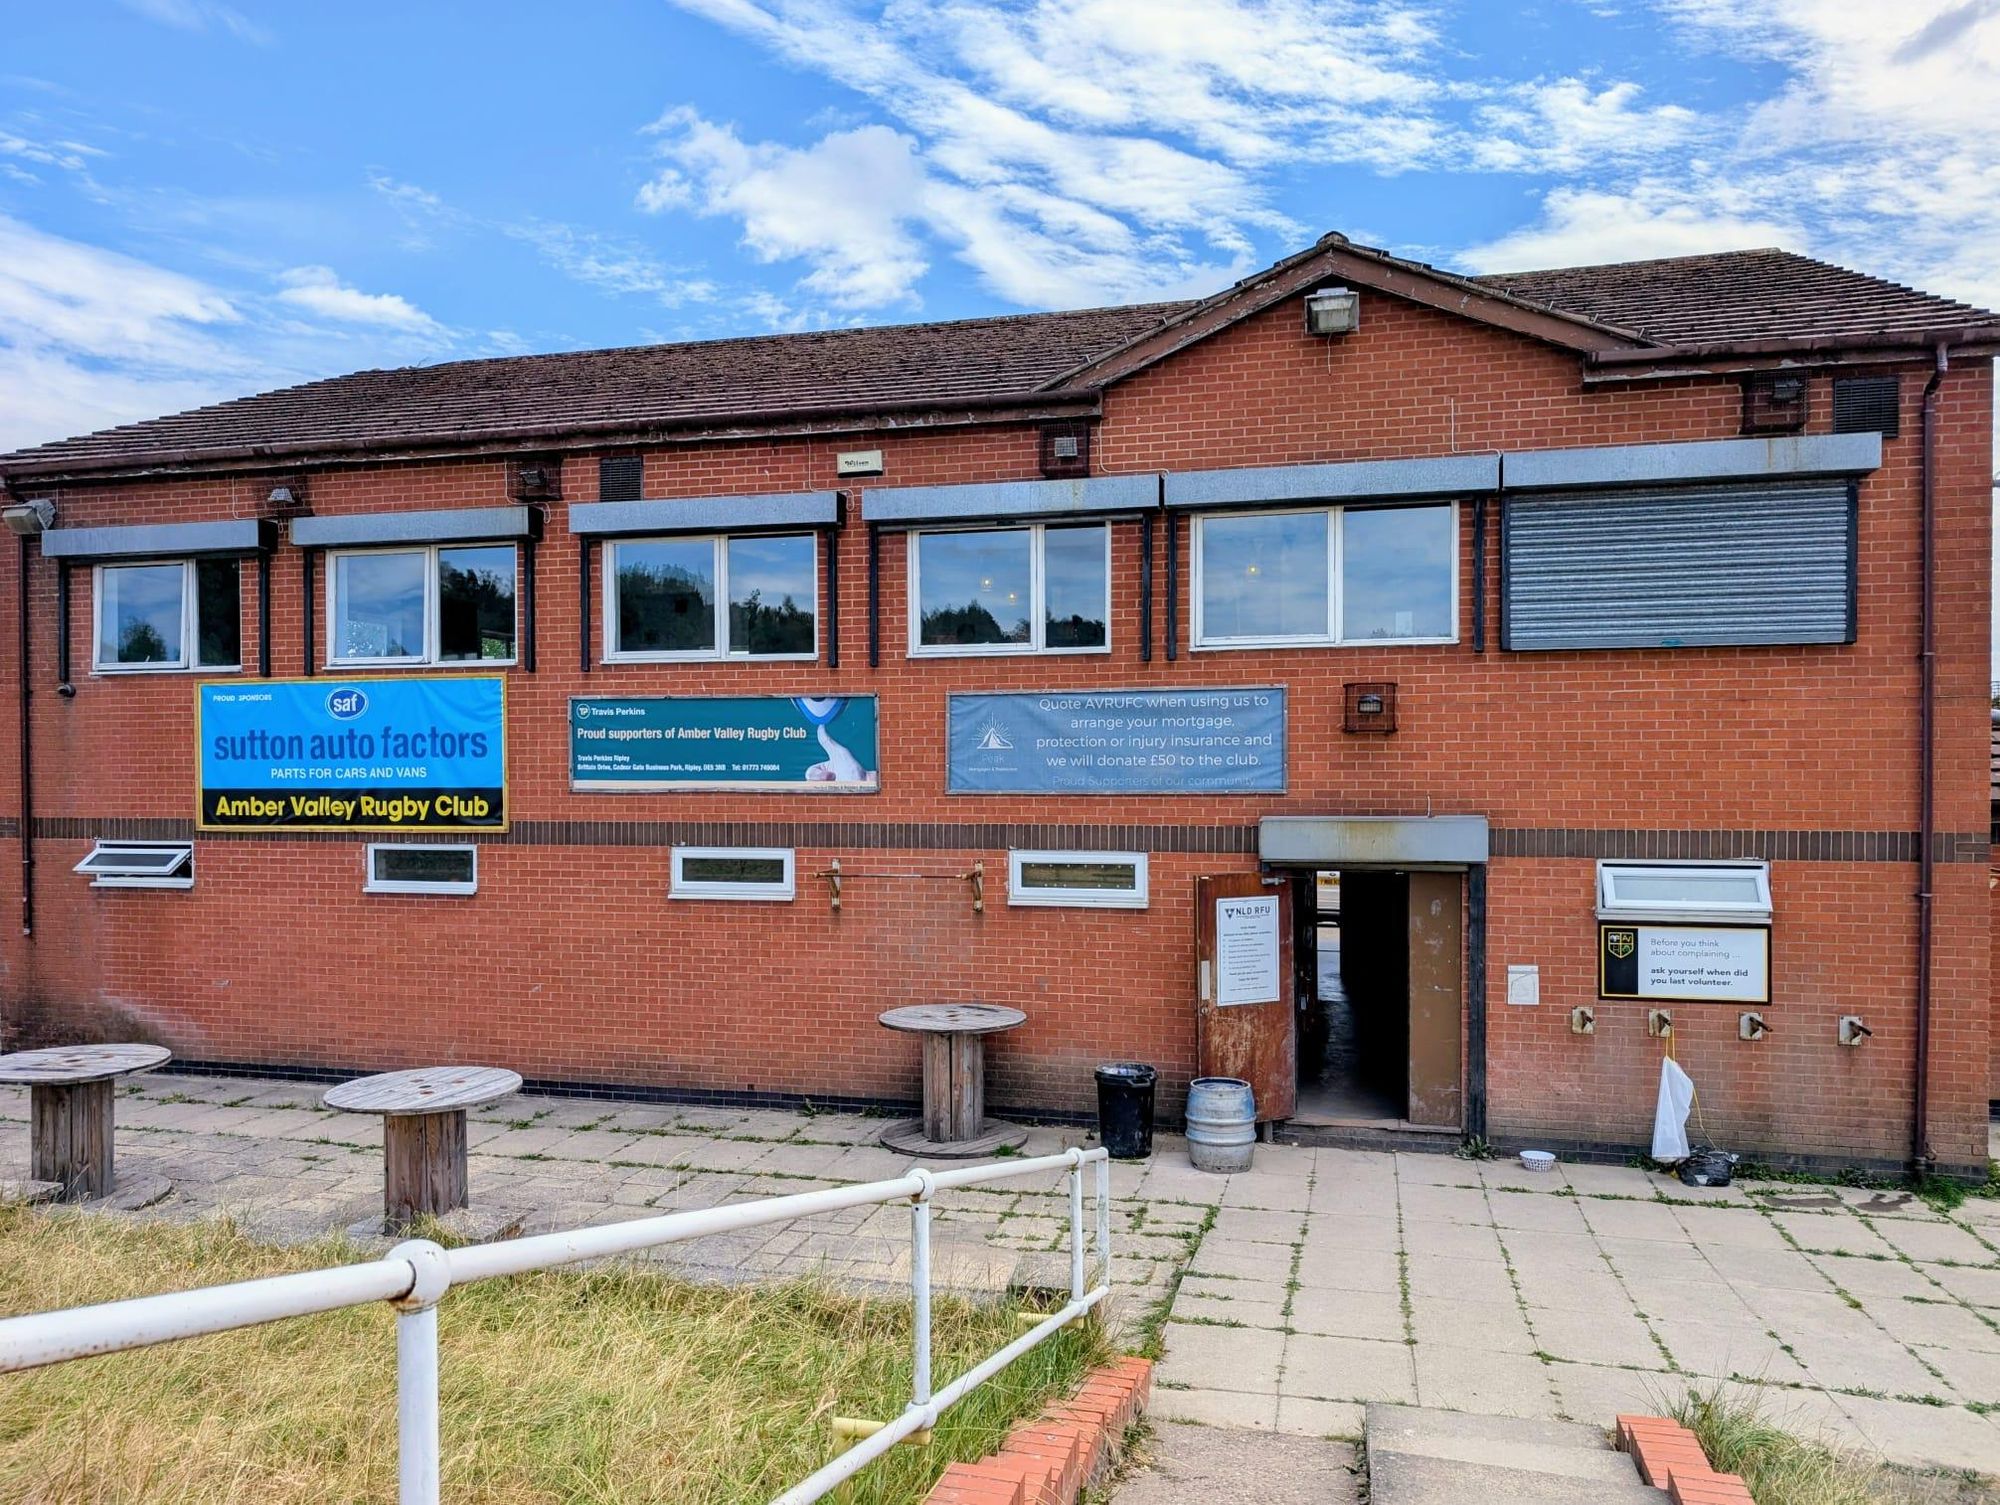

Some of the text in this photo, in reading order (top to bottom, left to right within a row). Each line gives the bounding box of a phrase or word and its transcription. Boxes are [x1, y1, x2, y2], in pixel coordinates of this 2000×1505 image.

[212, 694, 273, 702] PROUD SPONSORS
[333, 694, 357, 712] saf
[1039, 696, 1269, 711] Quote AVRUFC when using us to
[591, 707, 614, 716] Travis
[616, 706, 646, 716] Perkins
[1070, 717, 1123, 732] arrange
[1127, 717, 1158, 731] your
[577, 727, 806, 741] Proud supporters of Amber Valley Rugby Club
[214, 726, 488, 761] sutton auto factors
[1036, 733, 1272, 750] protection or injury insurance and
[1046, 754, 1261, 766] we will donate £50 to the club.
[271, 767, 427, 779] PARTS FOR CARS AND VANS
[1052, 776, 1256, 789] Proud Supporters of our community
[216, 796, 489, 822] Amber Valley Rugby Club
[1236, 907, 1252, 915] NLD
[1651, 938, 1718, 948] Before you think
[1651, 948, 1675, 956] about
[1678, 949, 1729, 959] complaining
[1651, 967, 1748, 977] ask yourself when did
[1651, 977, 1733, 987] you last volunteer.
